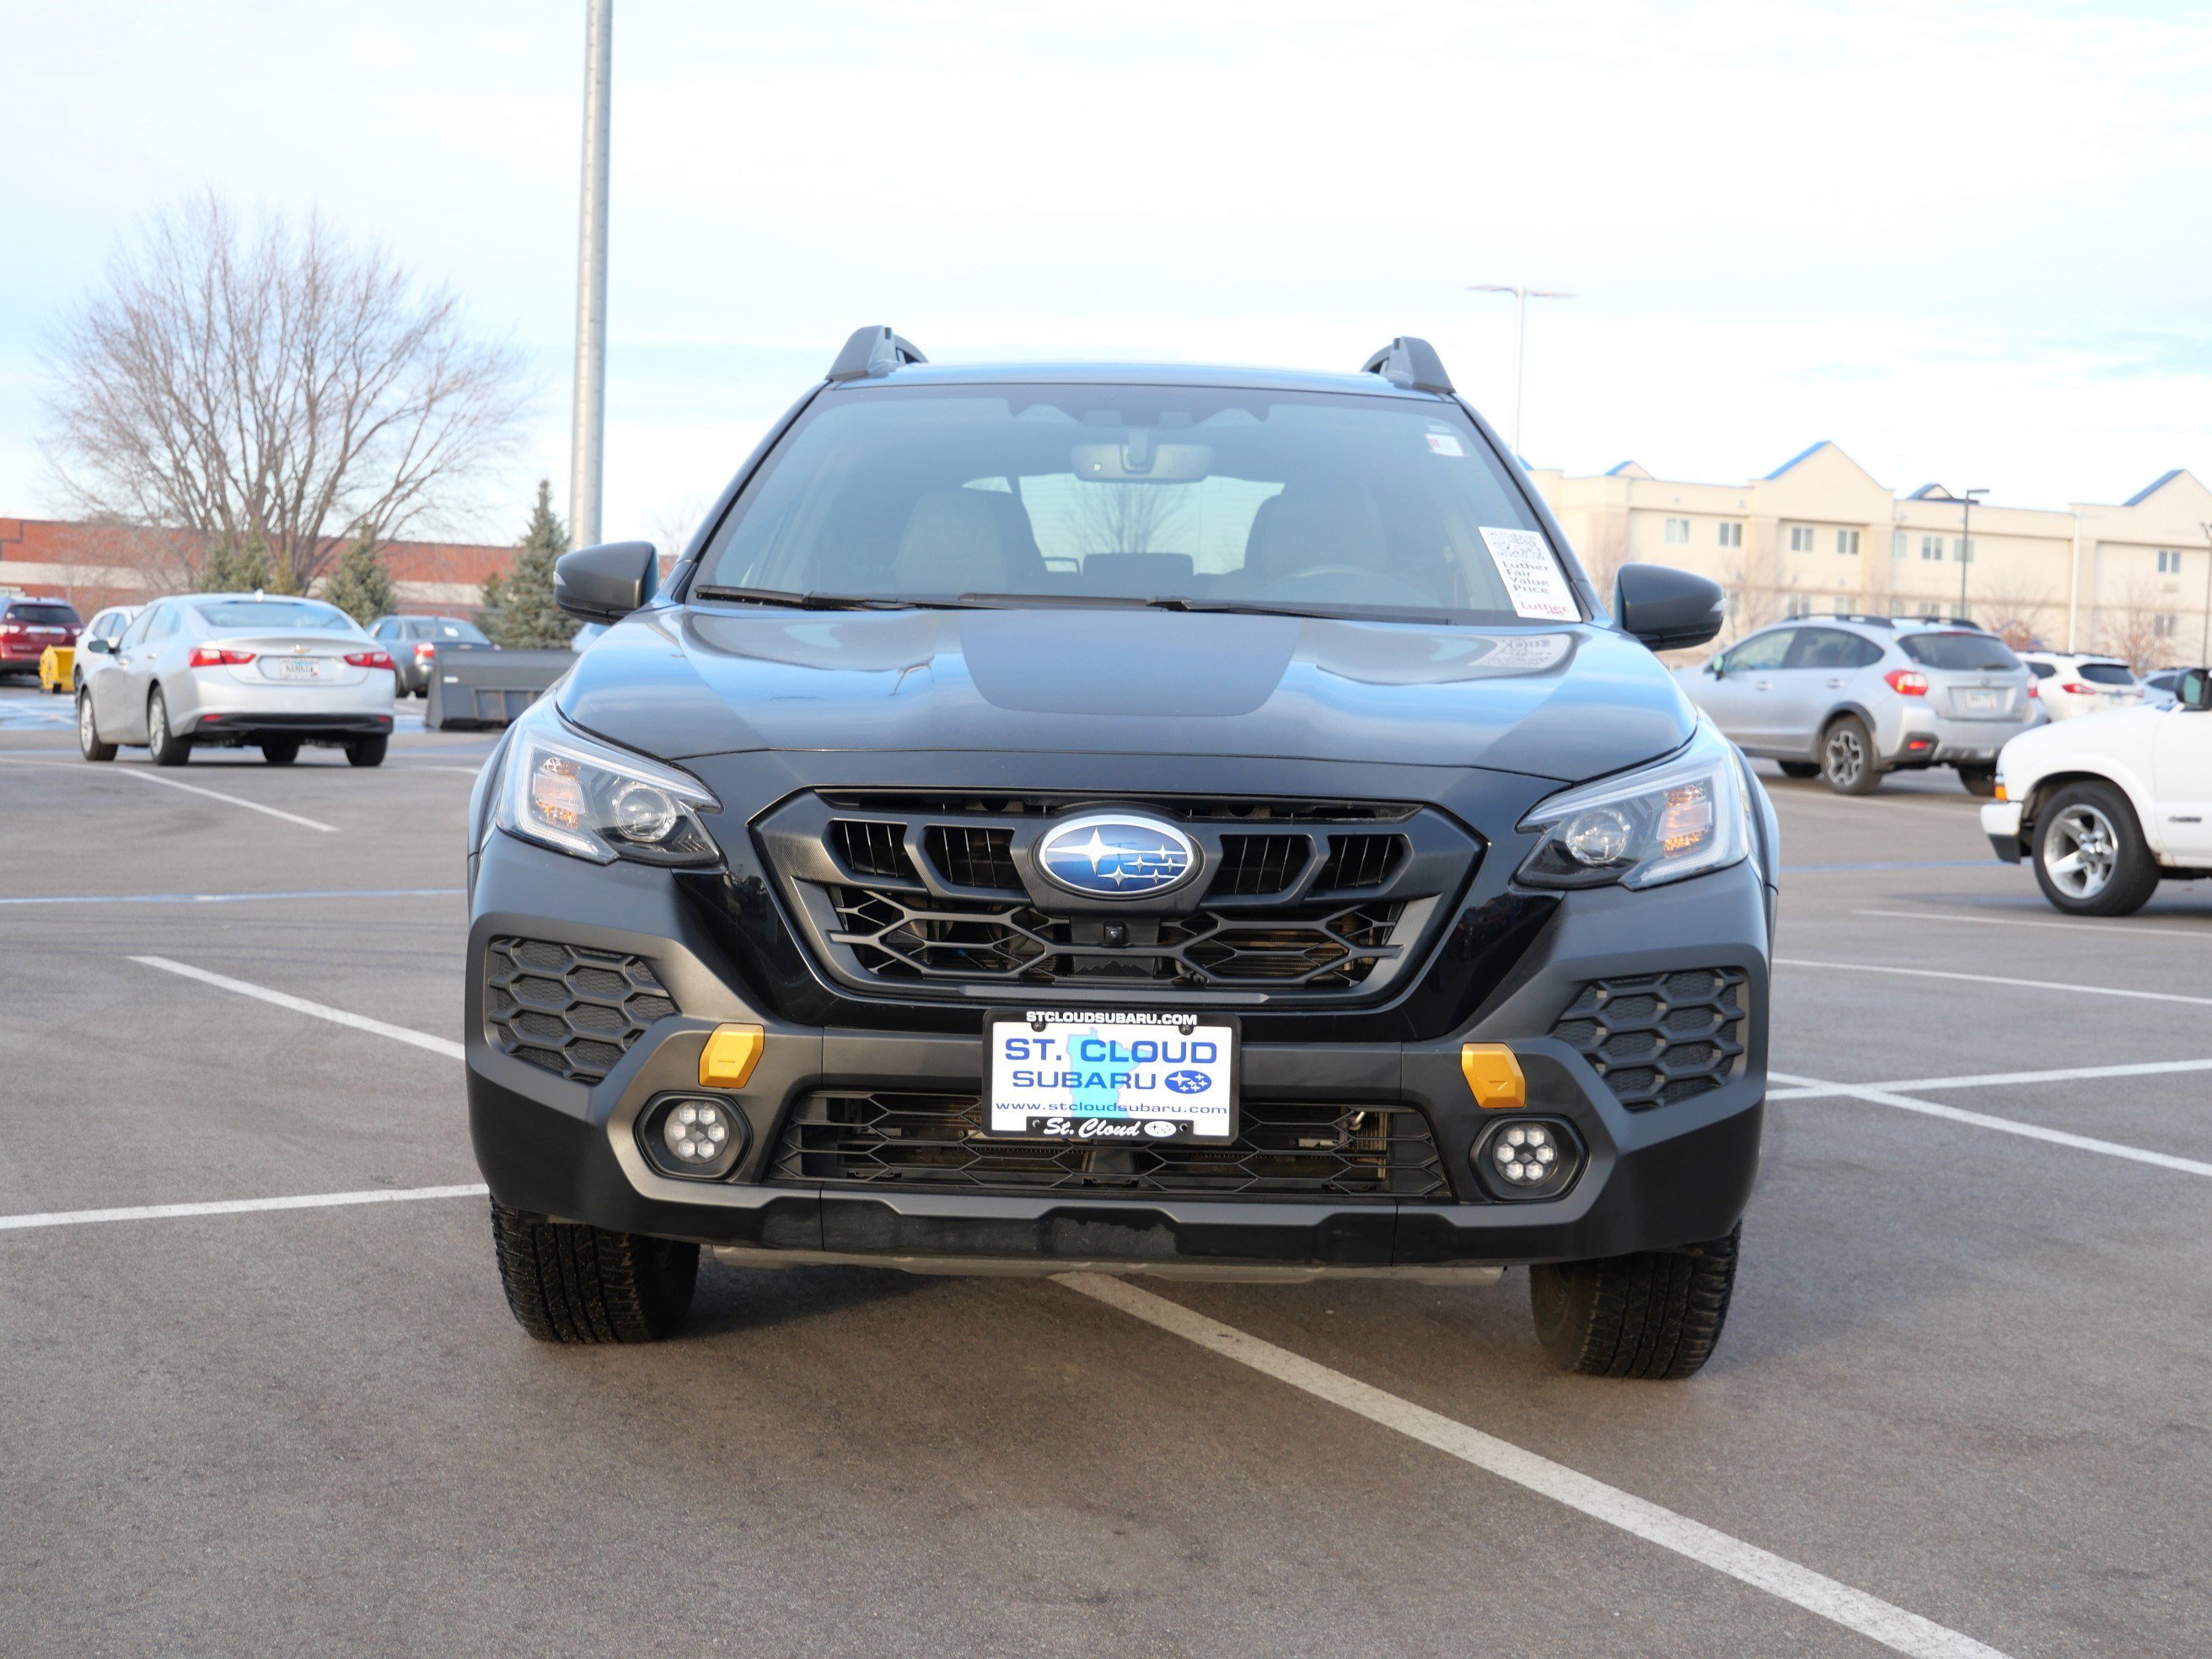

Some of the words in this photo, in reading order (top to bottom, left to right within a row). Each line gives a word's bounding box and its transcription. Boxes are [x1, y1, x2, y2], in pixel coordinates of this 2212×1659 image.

[1513, 584, 1549, 593] Price
[1026, 1011, 1197, 1025] STCLOUDSUBARU.COM
[1005, 1038, 1062, 1061] ST.
[1080, 1039, 1217, 1064] CLOUD
[1012, 1070, 1157, 1090] SUBARU
[996, 1102, 1227, 1114] www.stcloudsubaru.com
[1043, 1117, 1075, 1136] St.
[1078, 1118, 1141, 1138] Cloud
